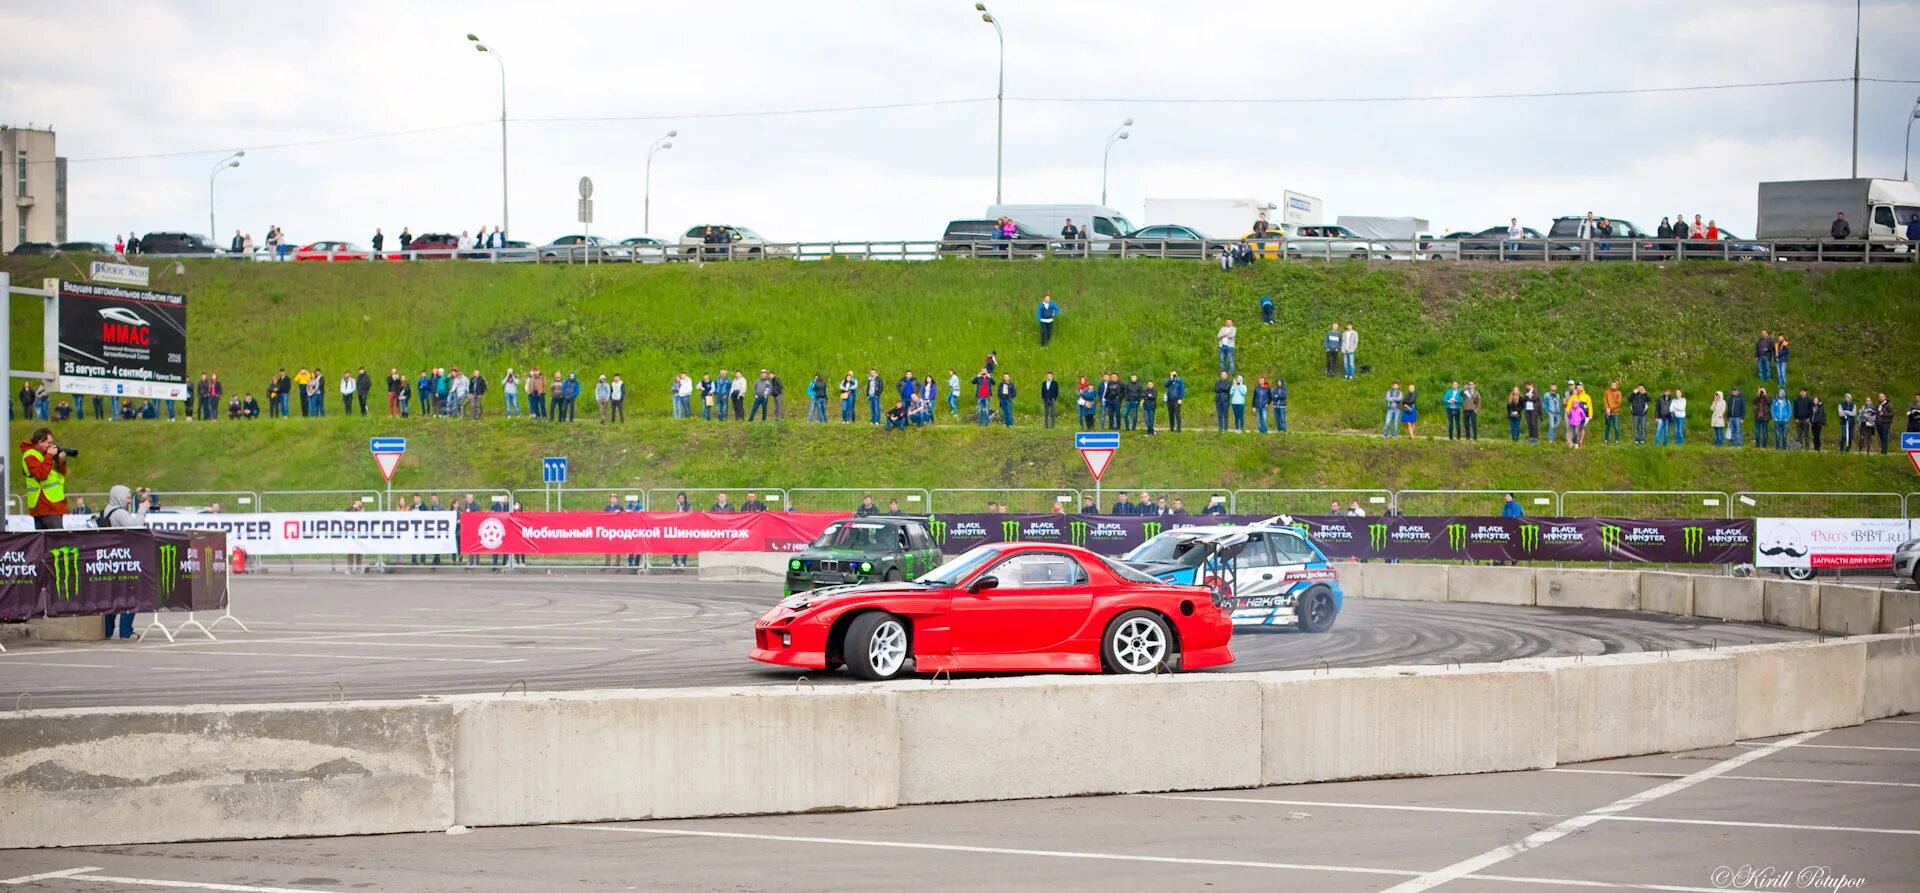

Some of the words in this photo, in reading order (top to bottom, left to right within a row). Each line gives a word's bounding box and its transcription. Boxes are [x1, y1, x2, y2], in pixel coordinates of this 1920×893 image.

[63, 281, 92, 295] Ведущее
[93, 286, 141, 299] автомобильное
[141, 291, 166, 303] событие
[167, 294, 183, 305] года!
[103, 322, 150, 346] ММАС
[64, 362, 75, 375] 25
[76, 365, 106, 377] августа
[112, 366, 118, 377] 4
[119, 367, 153, 381] сентября
[284, 520, 450, 540] QUADROCOPTER
[522, 526, 593, 538] Мобильный
[595, 526, 661, 540] Городской
[663, 526, 749, 539] Шиномонтаж
[1632, 527, 1659, 535] BLACK
[1811, 529, 1849, 543] PARTS
[1851, 529, 1906, 543] BBT.RU
[782, 542, 791, 551] +7
[0, 551, 26, 562] ACK
[96, 548, 131, 560] BLACK
[1813, 556, 1849, 565] ЗАПЧАСТИ
[1849, 556, 1863, 566] ДЛЯ
[0, 563, 37, 577] NSTER
[86, 560, 142, 575] MONSTER
